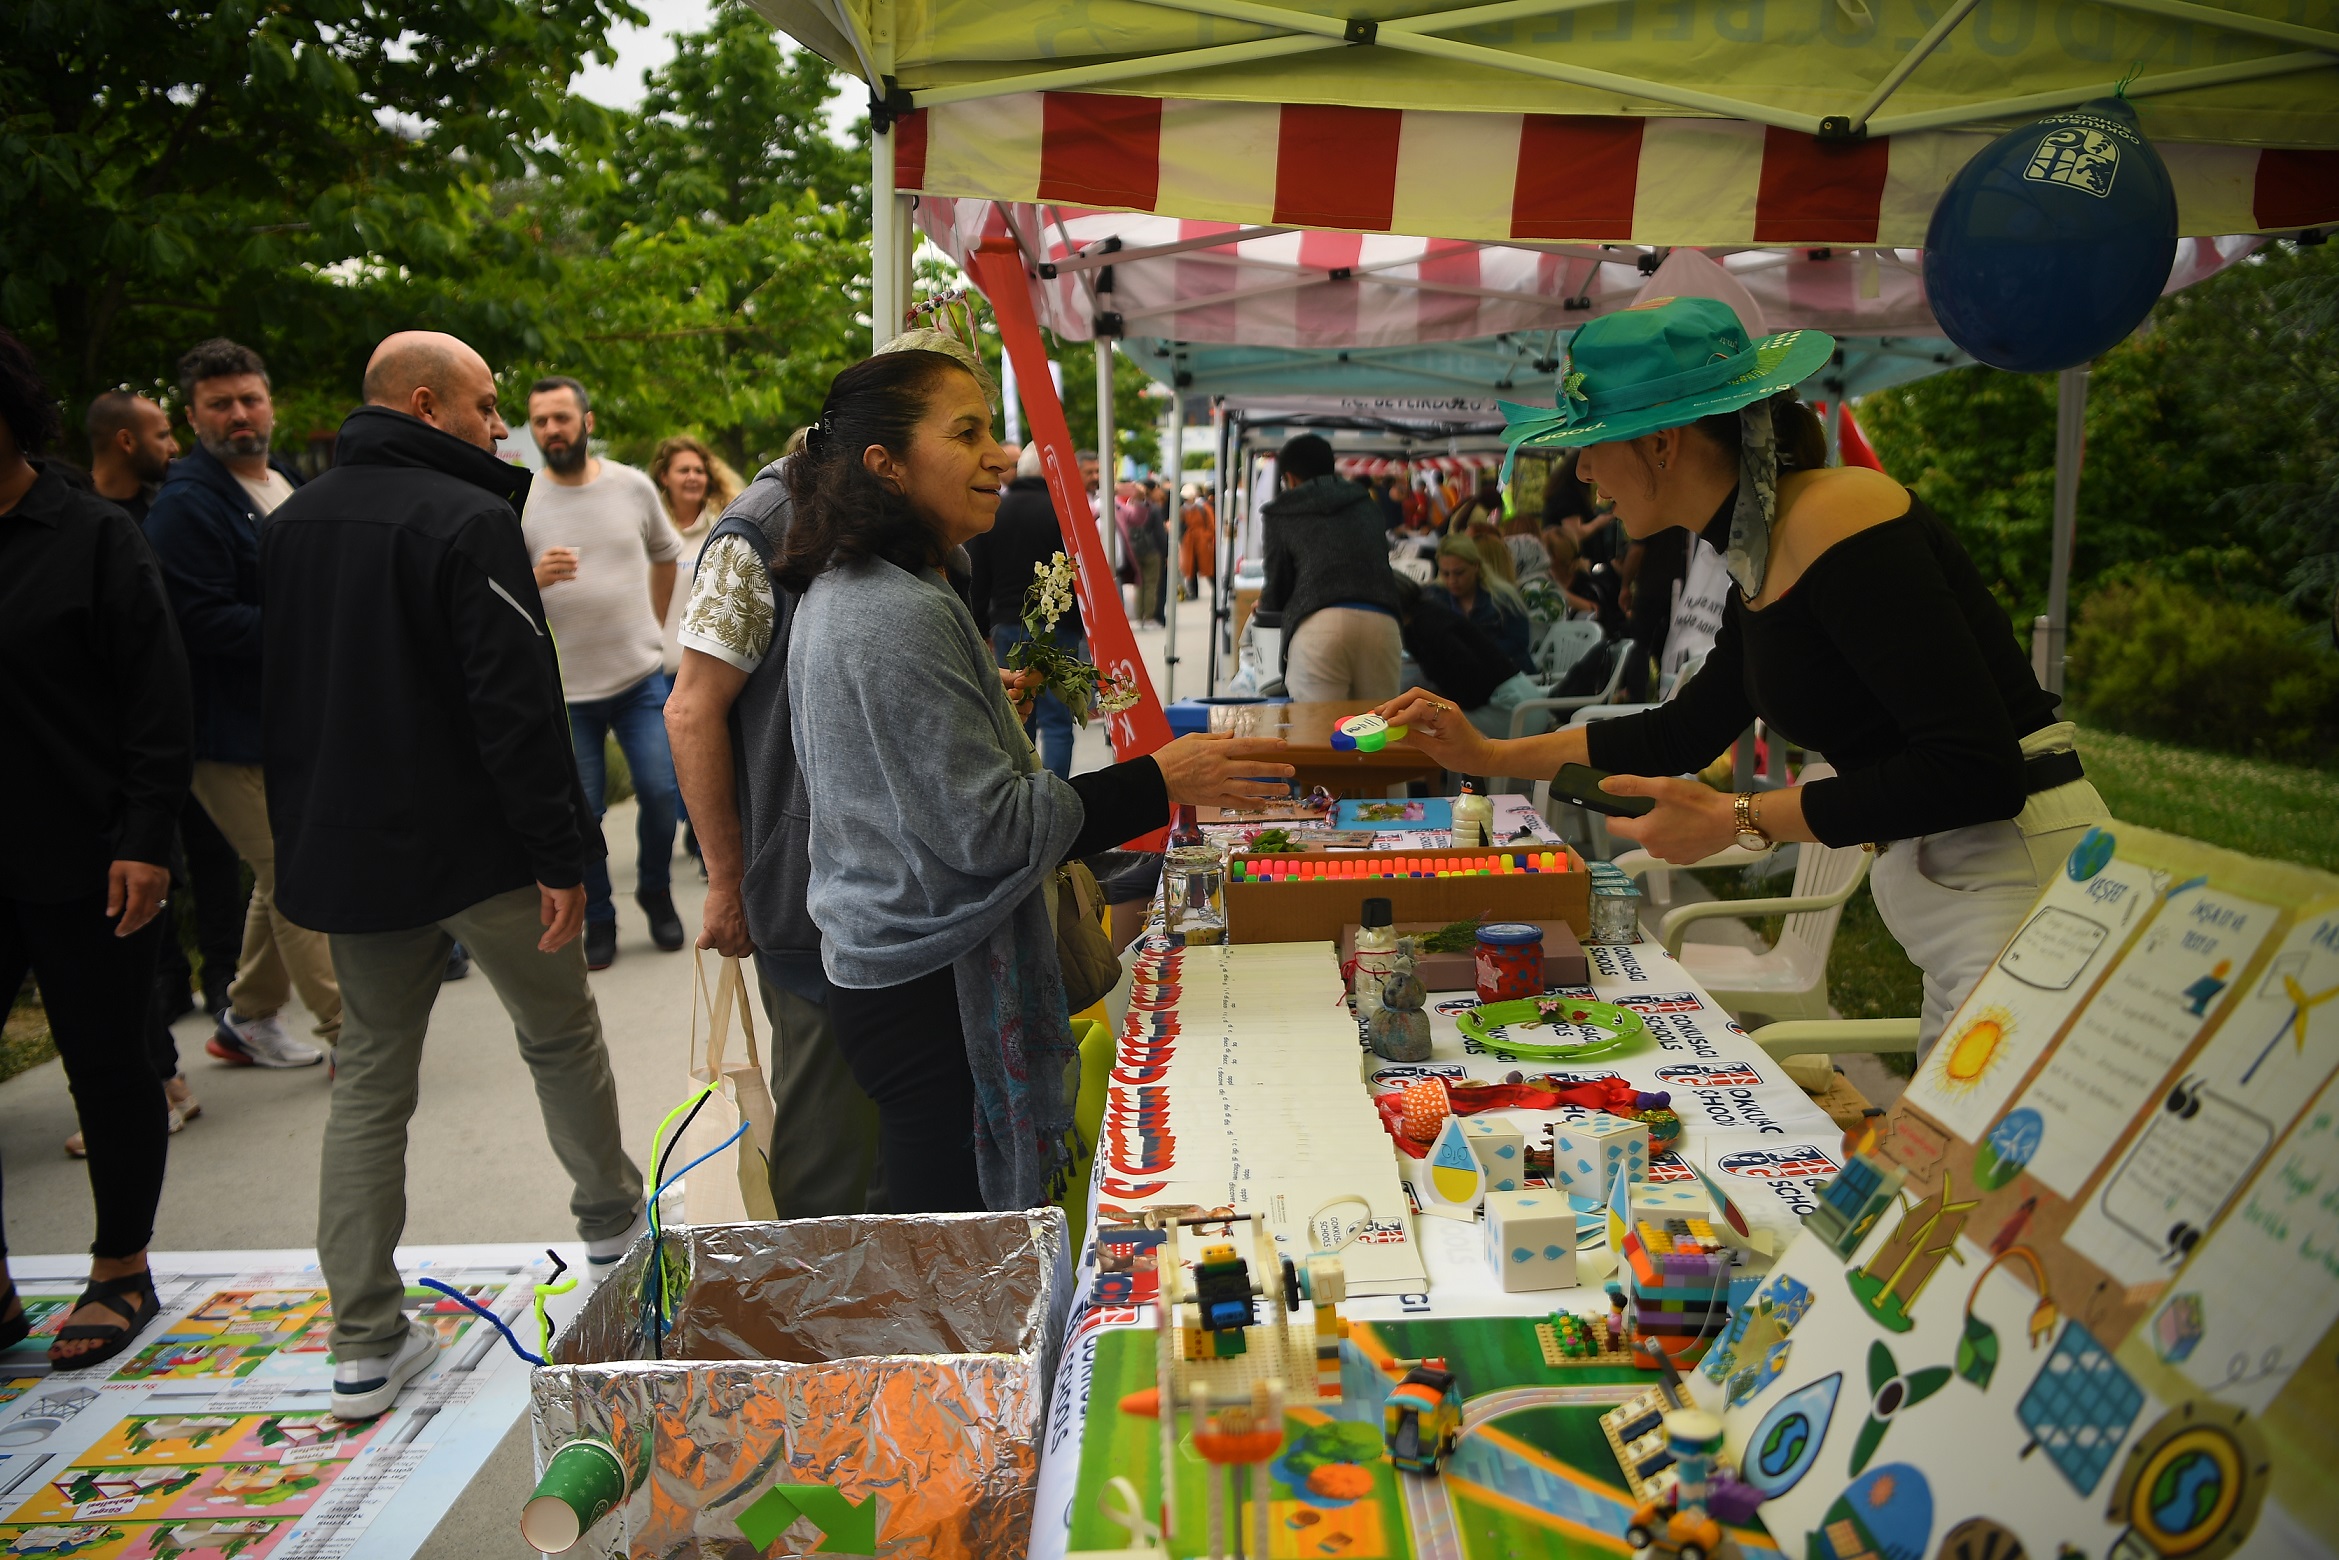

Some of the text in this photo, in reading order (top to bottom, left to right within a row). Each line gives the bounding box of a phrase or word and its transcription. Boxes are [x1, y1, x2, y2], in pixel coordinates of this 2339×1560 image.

[1589, 947, 1619, 976] SCHOOLS
[1612, 945, 1648, 982] GOKKUSAGI
[1642, 1014, 1684, 1051] SCHOOLS
[1668, 1013, 1720, 1058] GOKKUSAGI
